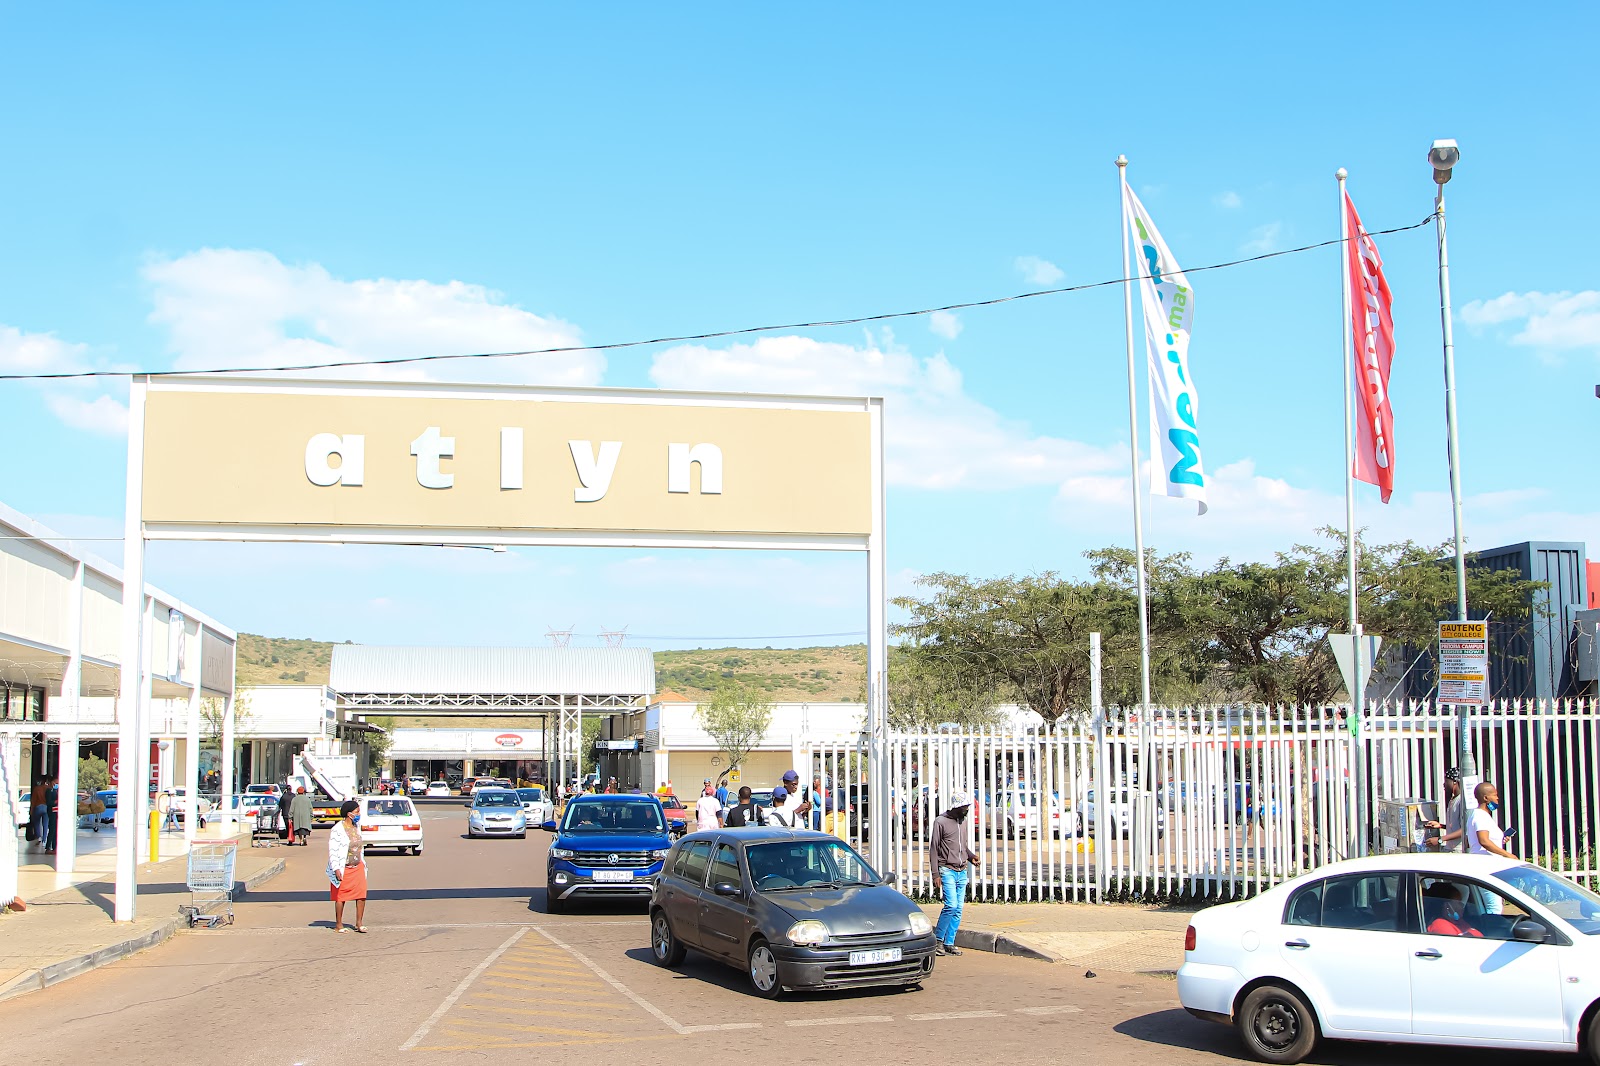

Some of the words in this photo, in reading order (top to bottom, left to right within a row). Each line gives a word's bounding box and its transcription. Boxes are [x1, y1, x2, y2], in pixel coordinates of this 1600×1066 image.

[304, 426, 724, 502] atlyn
[851, 953, 866, 964] RXH
[871, 951, 885, 962] 930
[891, 949, 901, 960] GP
